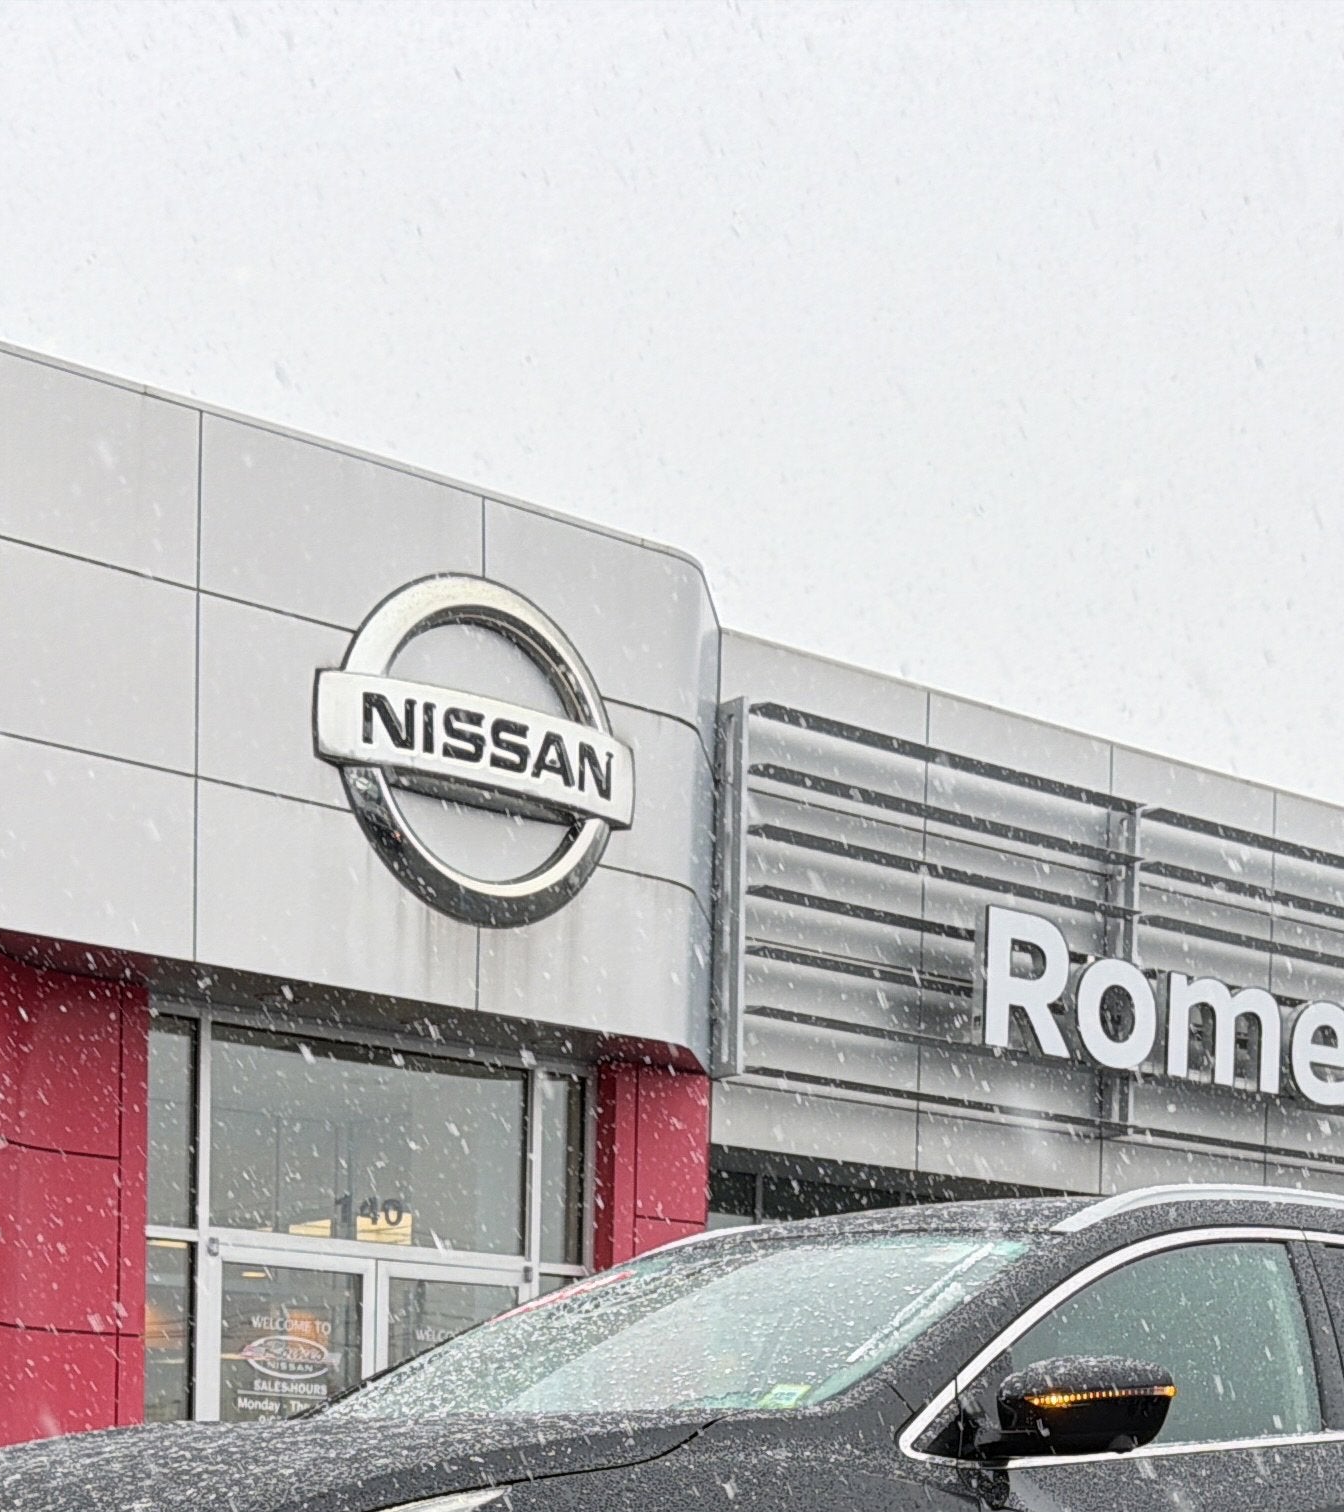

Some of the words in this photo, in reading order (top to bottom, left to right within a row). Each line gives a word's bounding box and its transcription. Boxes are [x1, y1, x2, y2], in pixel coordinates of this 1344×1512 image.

[362, 691, 614, 802] NISSAN
[335, 1194, 405, 1227] 140
[251, 1315, 314, 1332] WELCOME
[316, 1319, 332, 1336] TO
[416, 1328, 459, 1342] WELCO
[266, 1361, 314, 1373] NISSAN
[254, 1379, 289, 1394] SALES
[291, 1382, 328, 1397] HOURS
[237, 1397, 281, 1412] Monday
